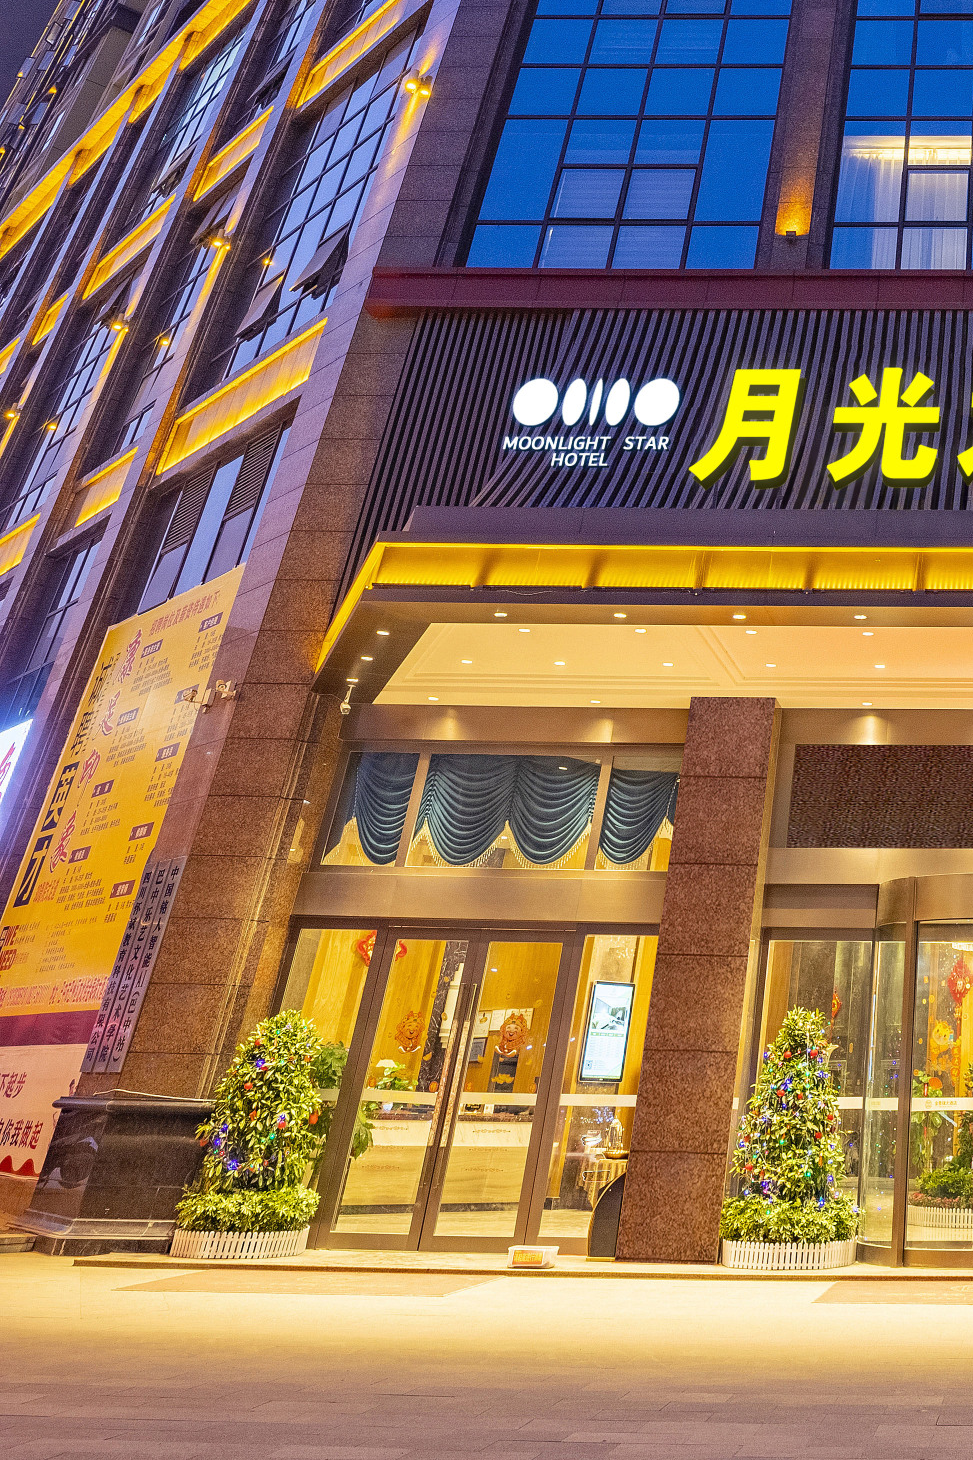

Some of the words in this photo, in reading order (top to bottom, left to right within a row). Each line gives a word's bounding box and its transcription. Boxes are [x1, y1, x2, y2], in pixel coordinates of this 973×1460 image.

[502, 436, 612, 450] MOONLIGHT
[623, 436, 670, 450] STAR
[550, 452, 608, 467] HOTEL
[14, 654, 115, 907] 诚聘英才
